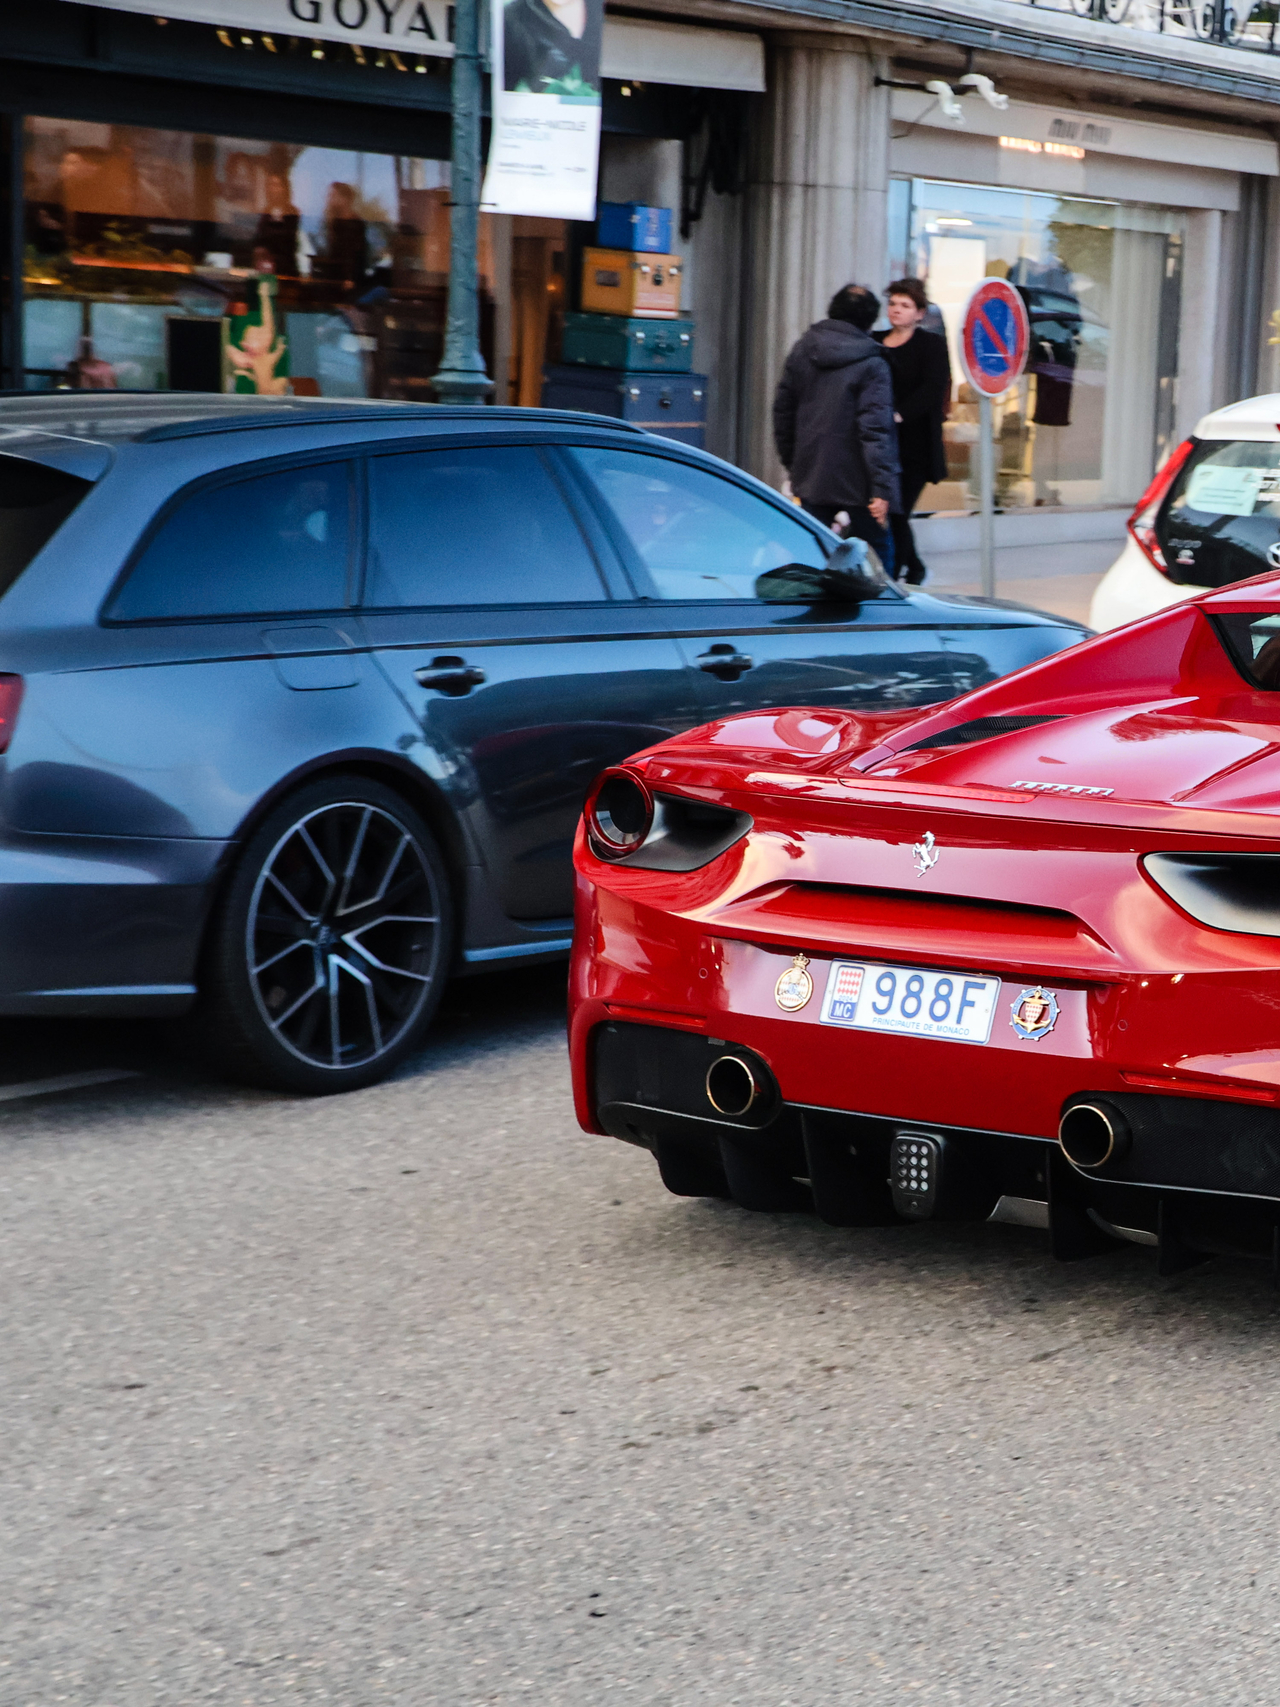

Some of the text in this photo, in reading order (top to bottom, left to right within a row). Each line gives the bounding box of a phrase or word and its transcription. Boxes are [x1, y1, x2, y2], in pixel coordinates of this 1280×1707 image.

[288, 0, 456, 43] GOYA
[833, 1002, 852, 1018] MC
[872, 971, 987, 1025] 988F
[872, 1017, 970, 1036] PRINCIPAUTE DE MONACO
